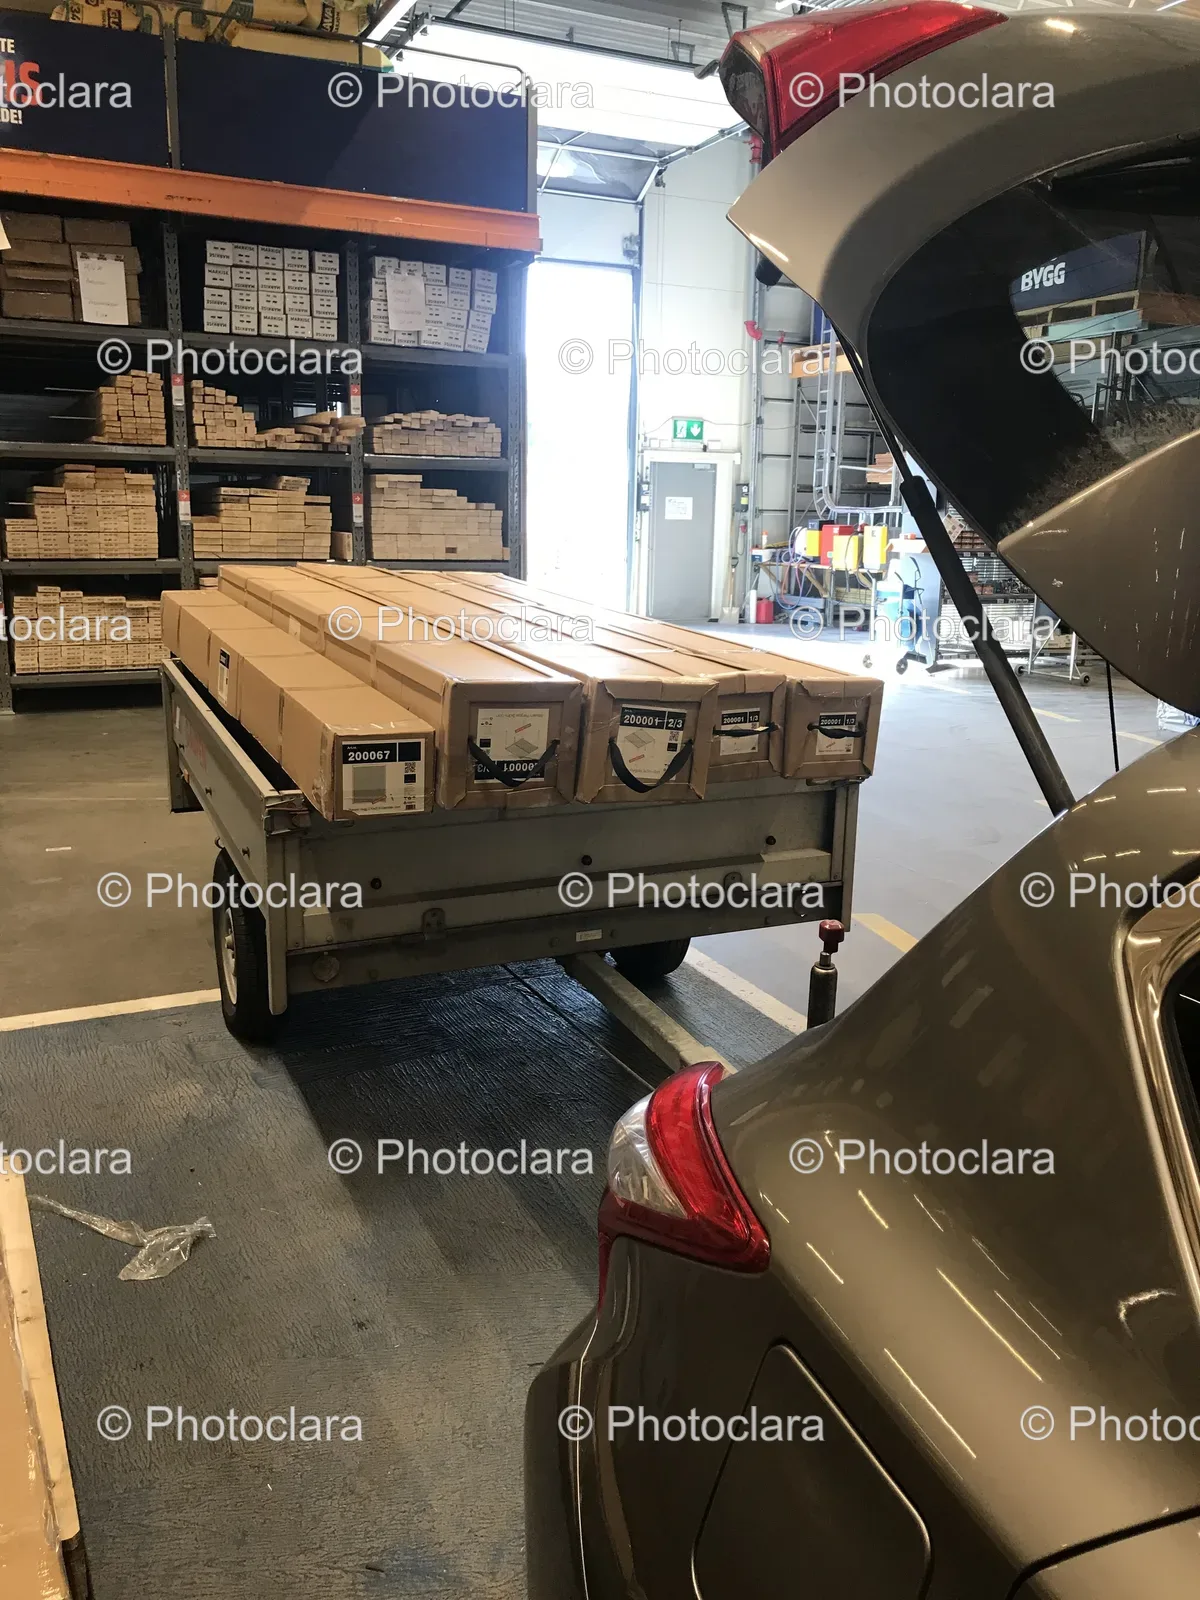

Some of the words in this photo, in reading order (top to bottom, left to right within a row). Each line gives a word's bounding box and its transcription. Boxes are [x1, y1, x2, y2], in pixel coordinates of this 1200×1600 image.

[0, 108, 23, 124] DE!
[1021, 262, 1066, 292] BYGG
[624, 715, 659, 726] 200001
[668, 719, 683, 728] 2/3
[348, 750, 390, 761] 200067
[503, 762, 538, 772] 00001
